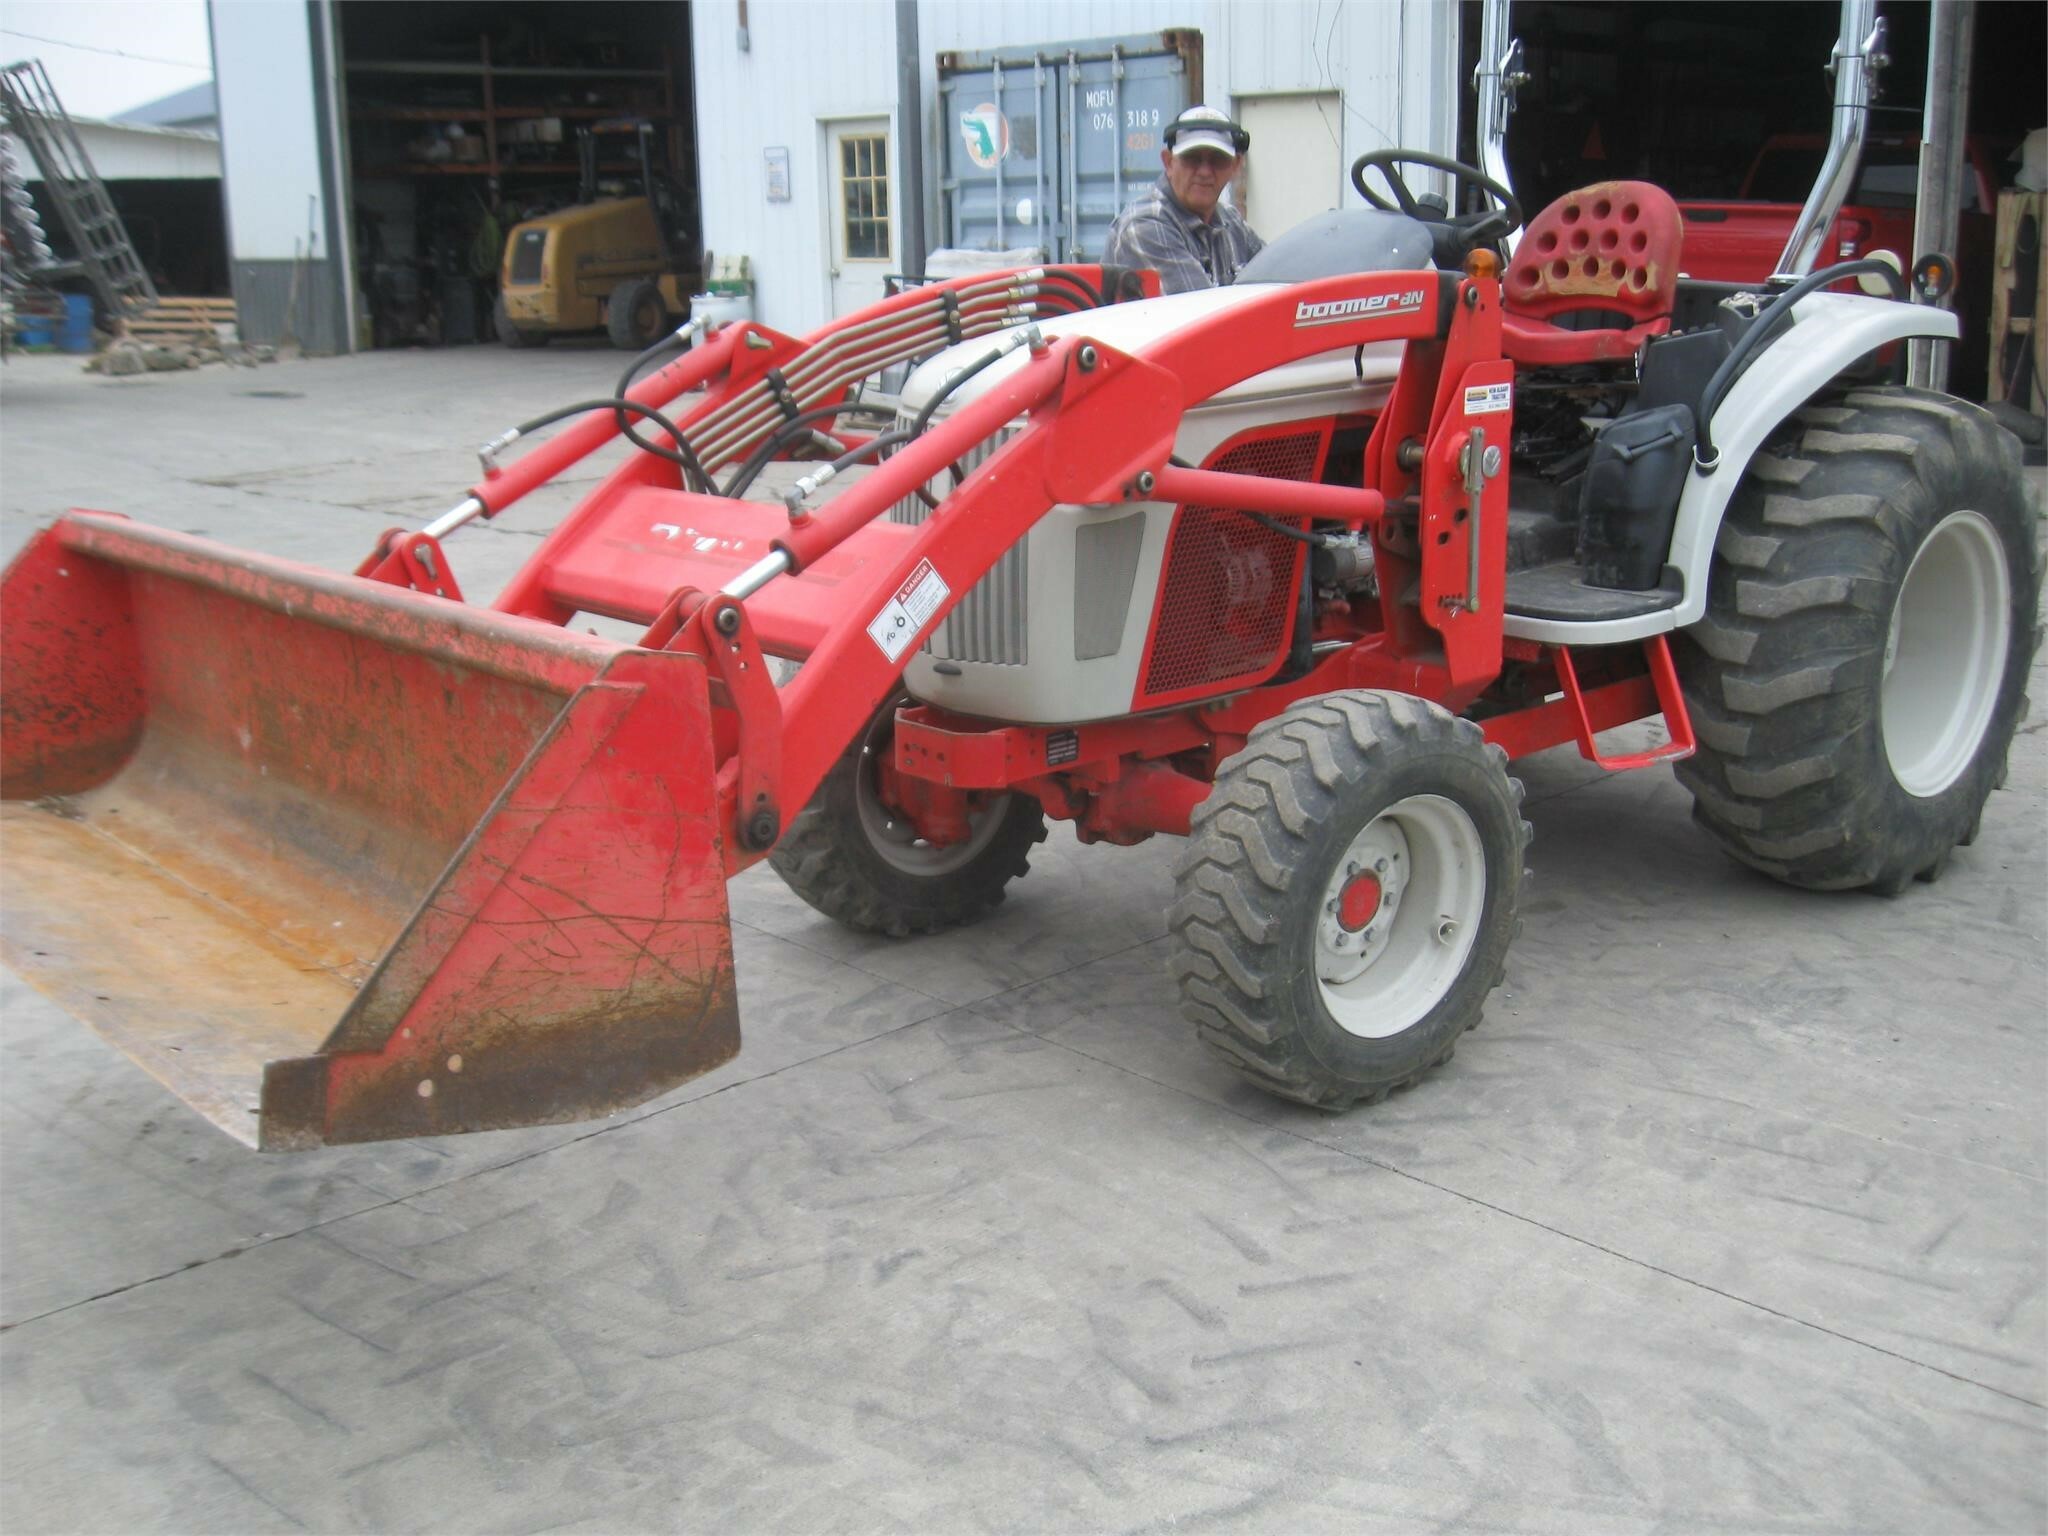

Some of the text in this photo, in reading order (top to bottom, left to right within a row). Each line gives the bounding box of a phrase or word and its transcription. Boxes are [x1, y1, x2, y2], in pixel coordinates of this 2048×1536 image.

[1086, 89, 1114, 108] MOFU
[1093, 108, 1159, 130] 076 318 9
[1296, 293, 1399, 320] boomer
[904, 564, 929, 593] DANGER
